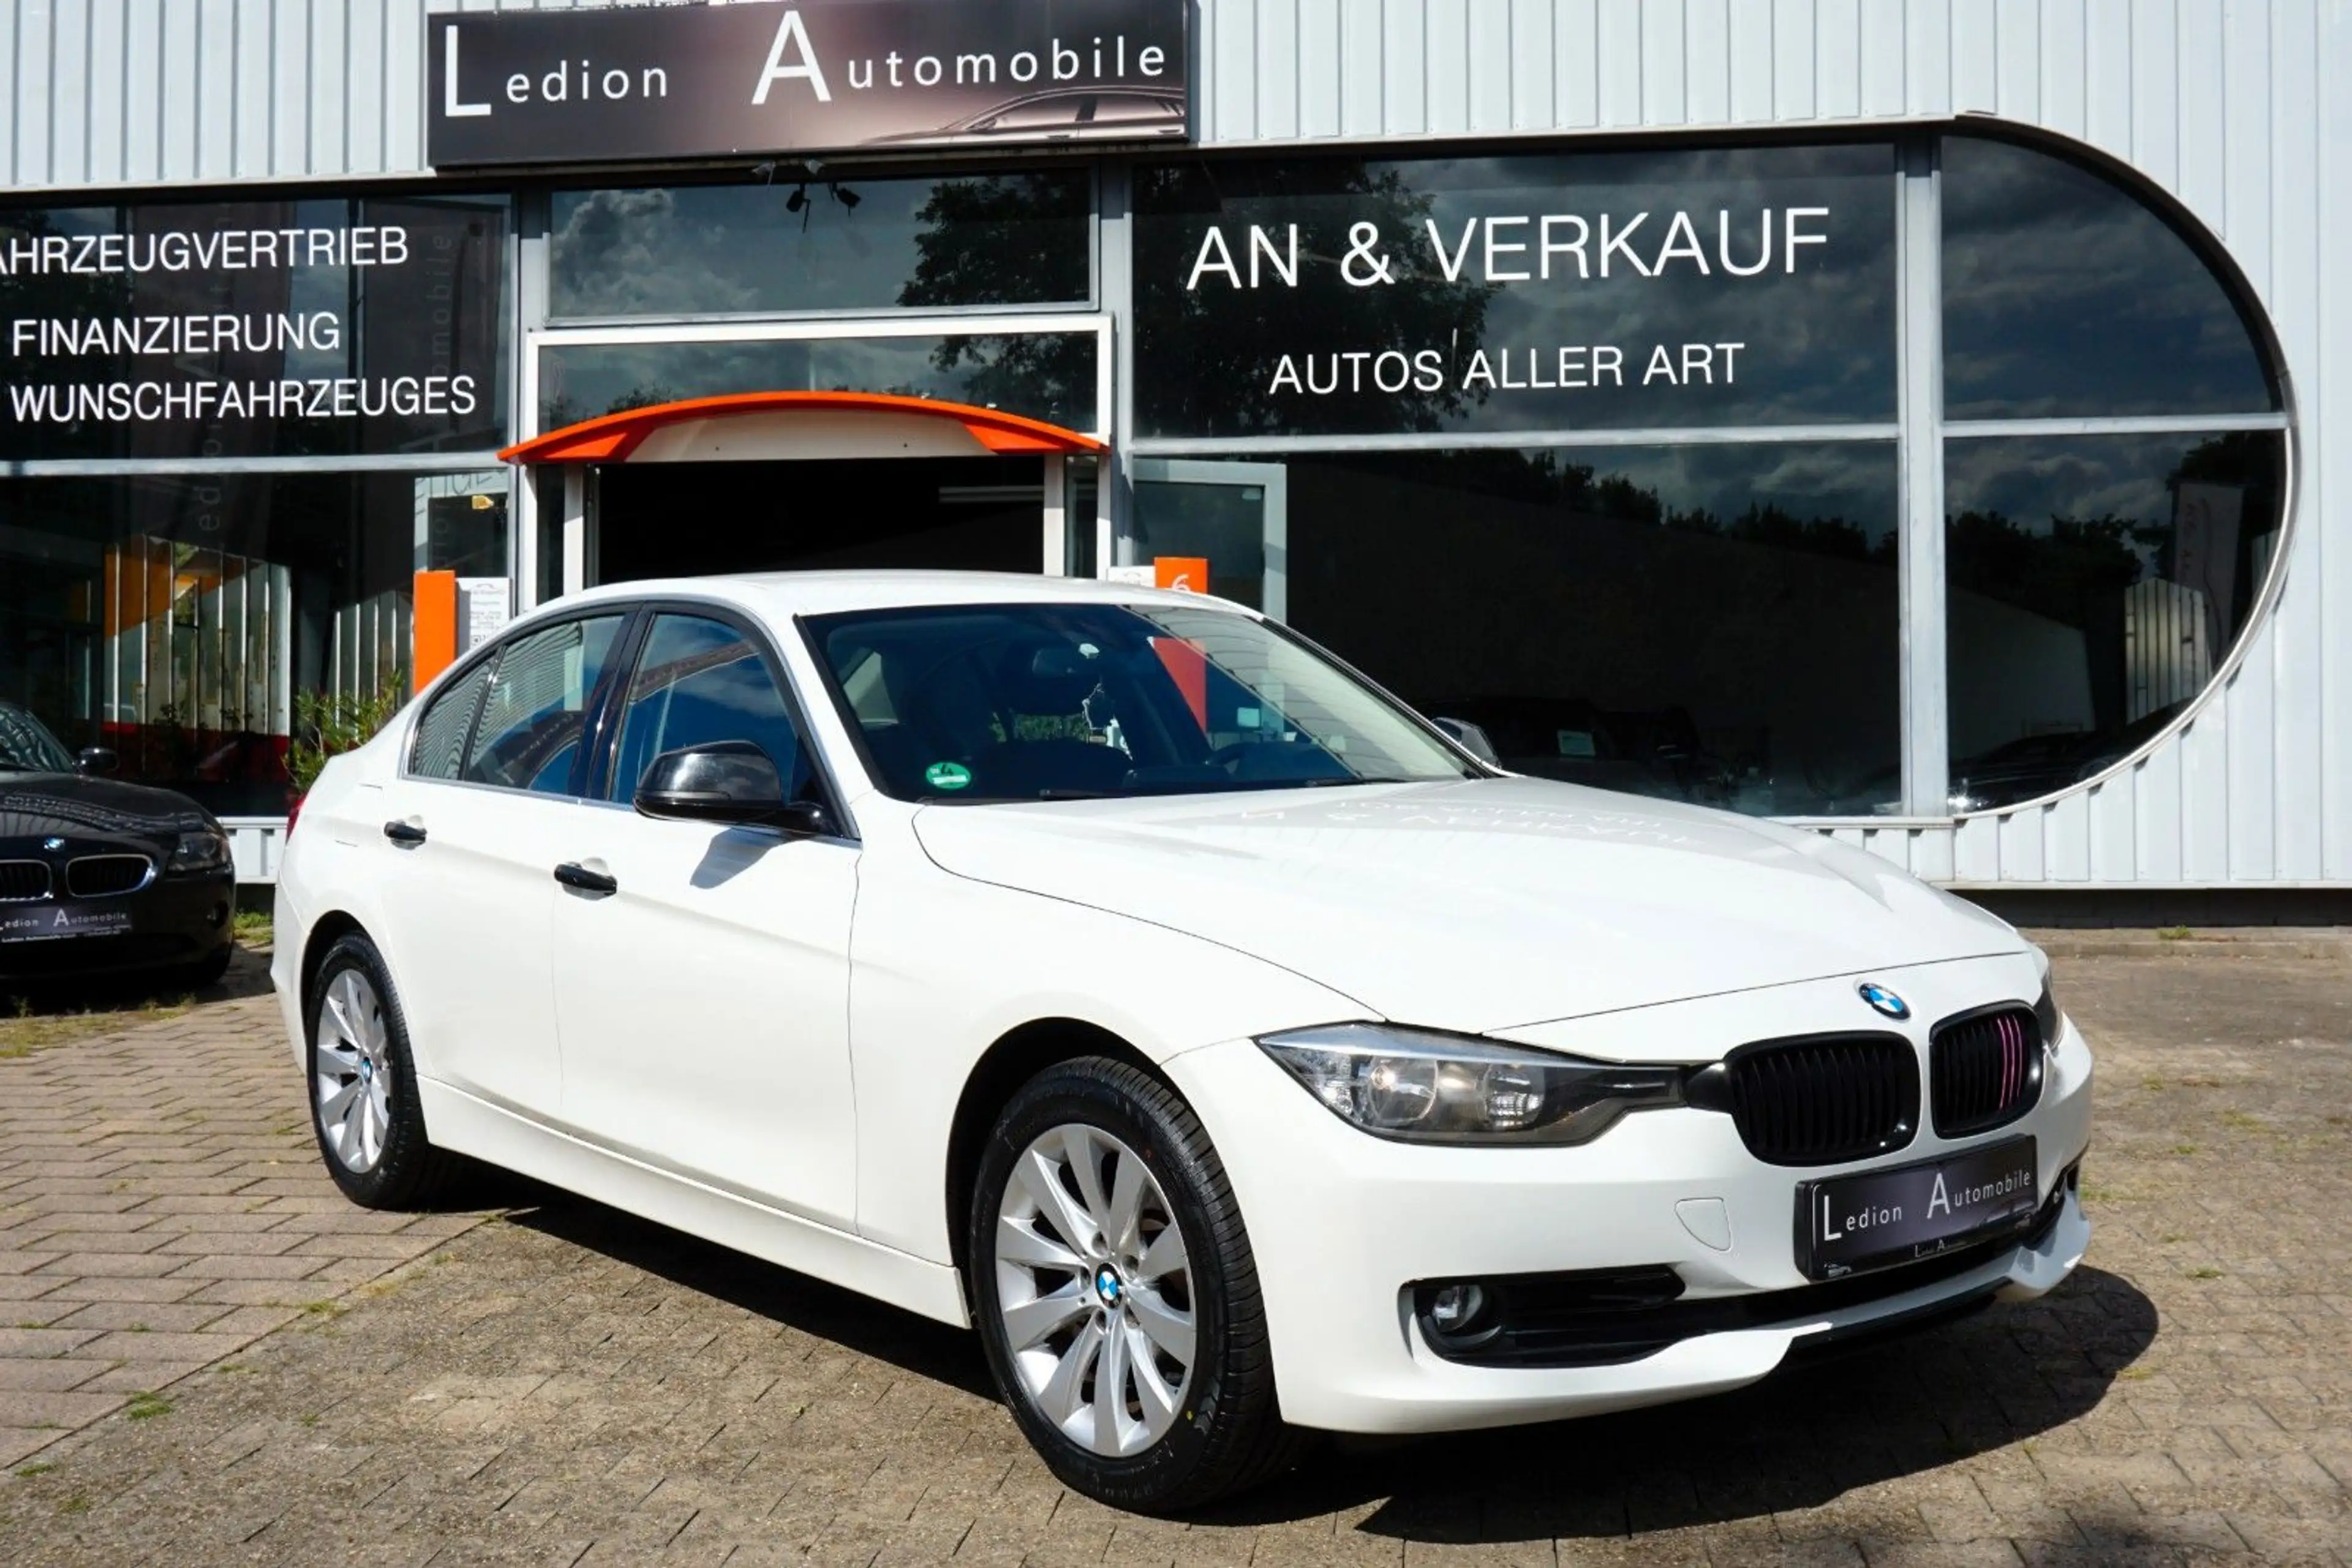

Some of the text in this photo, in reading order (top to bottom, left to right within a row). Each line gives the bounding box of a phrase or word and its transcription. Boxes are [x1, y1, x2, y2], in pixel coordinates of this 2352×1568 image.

[446, 10, 1164, 117] Ledion Automobile
[0, 226, 408, 274] HRZEUGVERTRIEB
[1186, 207, 1830, 290] AN & VERKAUF
[13, 311, 340, 356] FINANZIERUNG
[1269, 342, 1745, 394] AUTOS ALLER ART
[10, 375, 475, 422] WUNSCHFAHRZEUGES
[1824, 1172, 2030, 1241] Ledion Automobile
